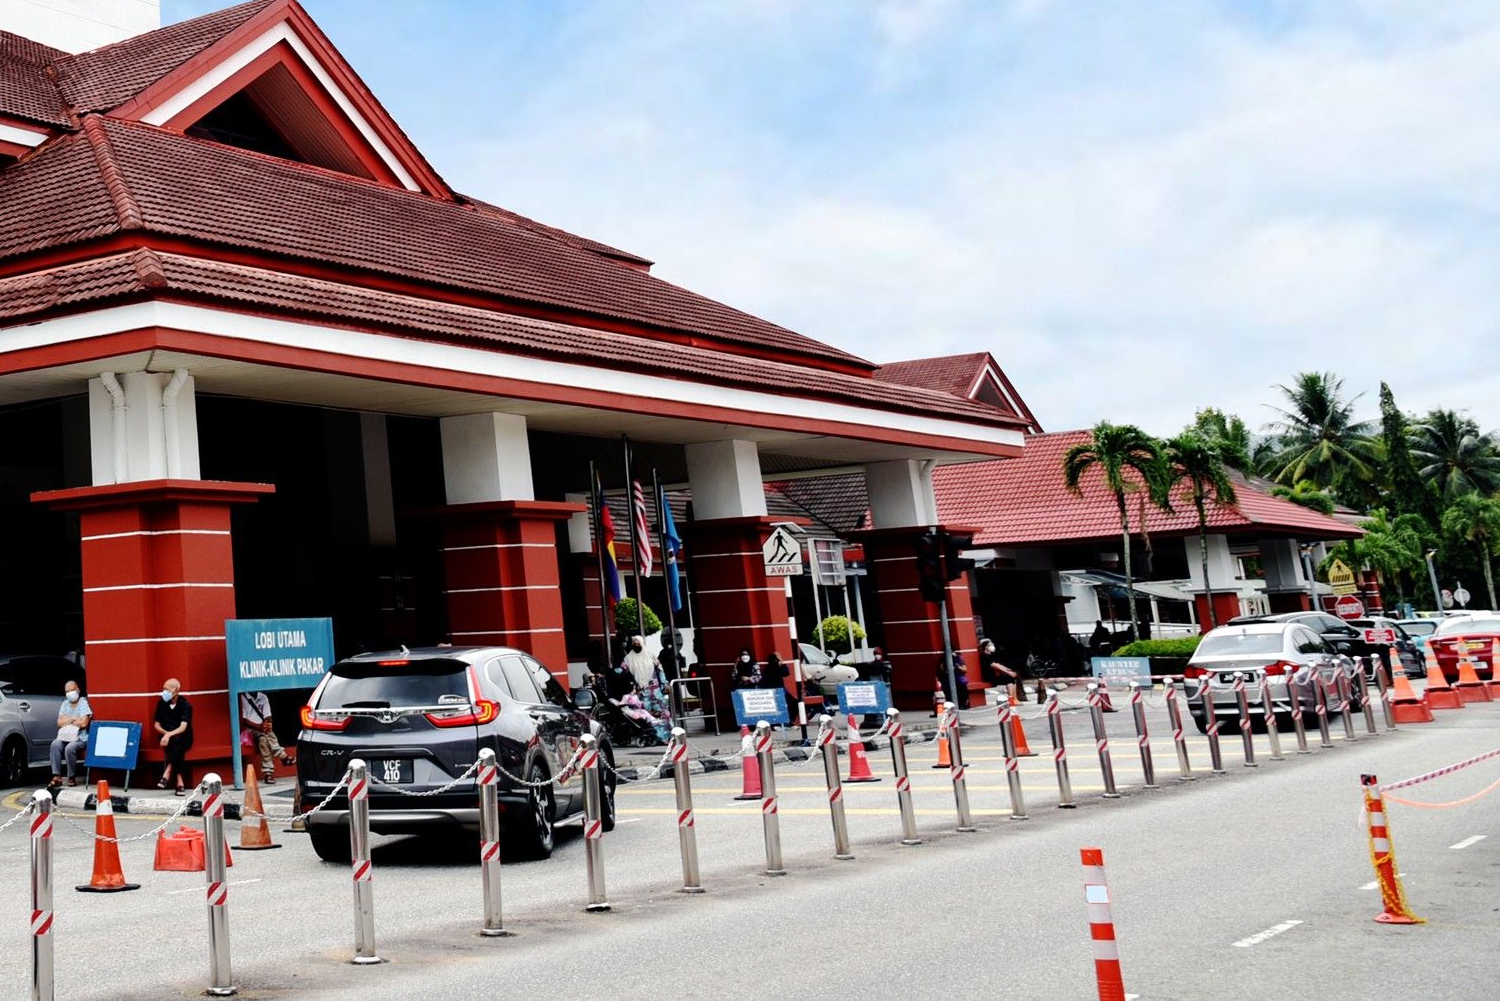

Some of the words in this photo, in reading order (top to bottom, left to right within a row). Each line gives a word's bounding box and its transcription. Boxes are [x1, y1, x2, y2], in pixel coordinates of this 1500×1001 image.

[770, 565, 798, 575] AWAS
[254, 631, 276, 649] LOBI
[277, 630, 307, 648] UTAMA
[240, 659, 297, 678] KLINIK-KLINIK
[296, 657, 325, 675] PAKAR
[383, 759, 401, 771] VCF
[383, 769, 401, 781] 410
